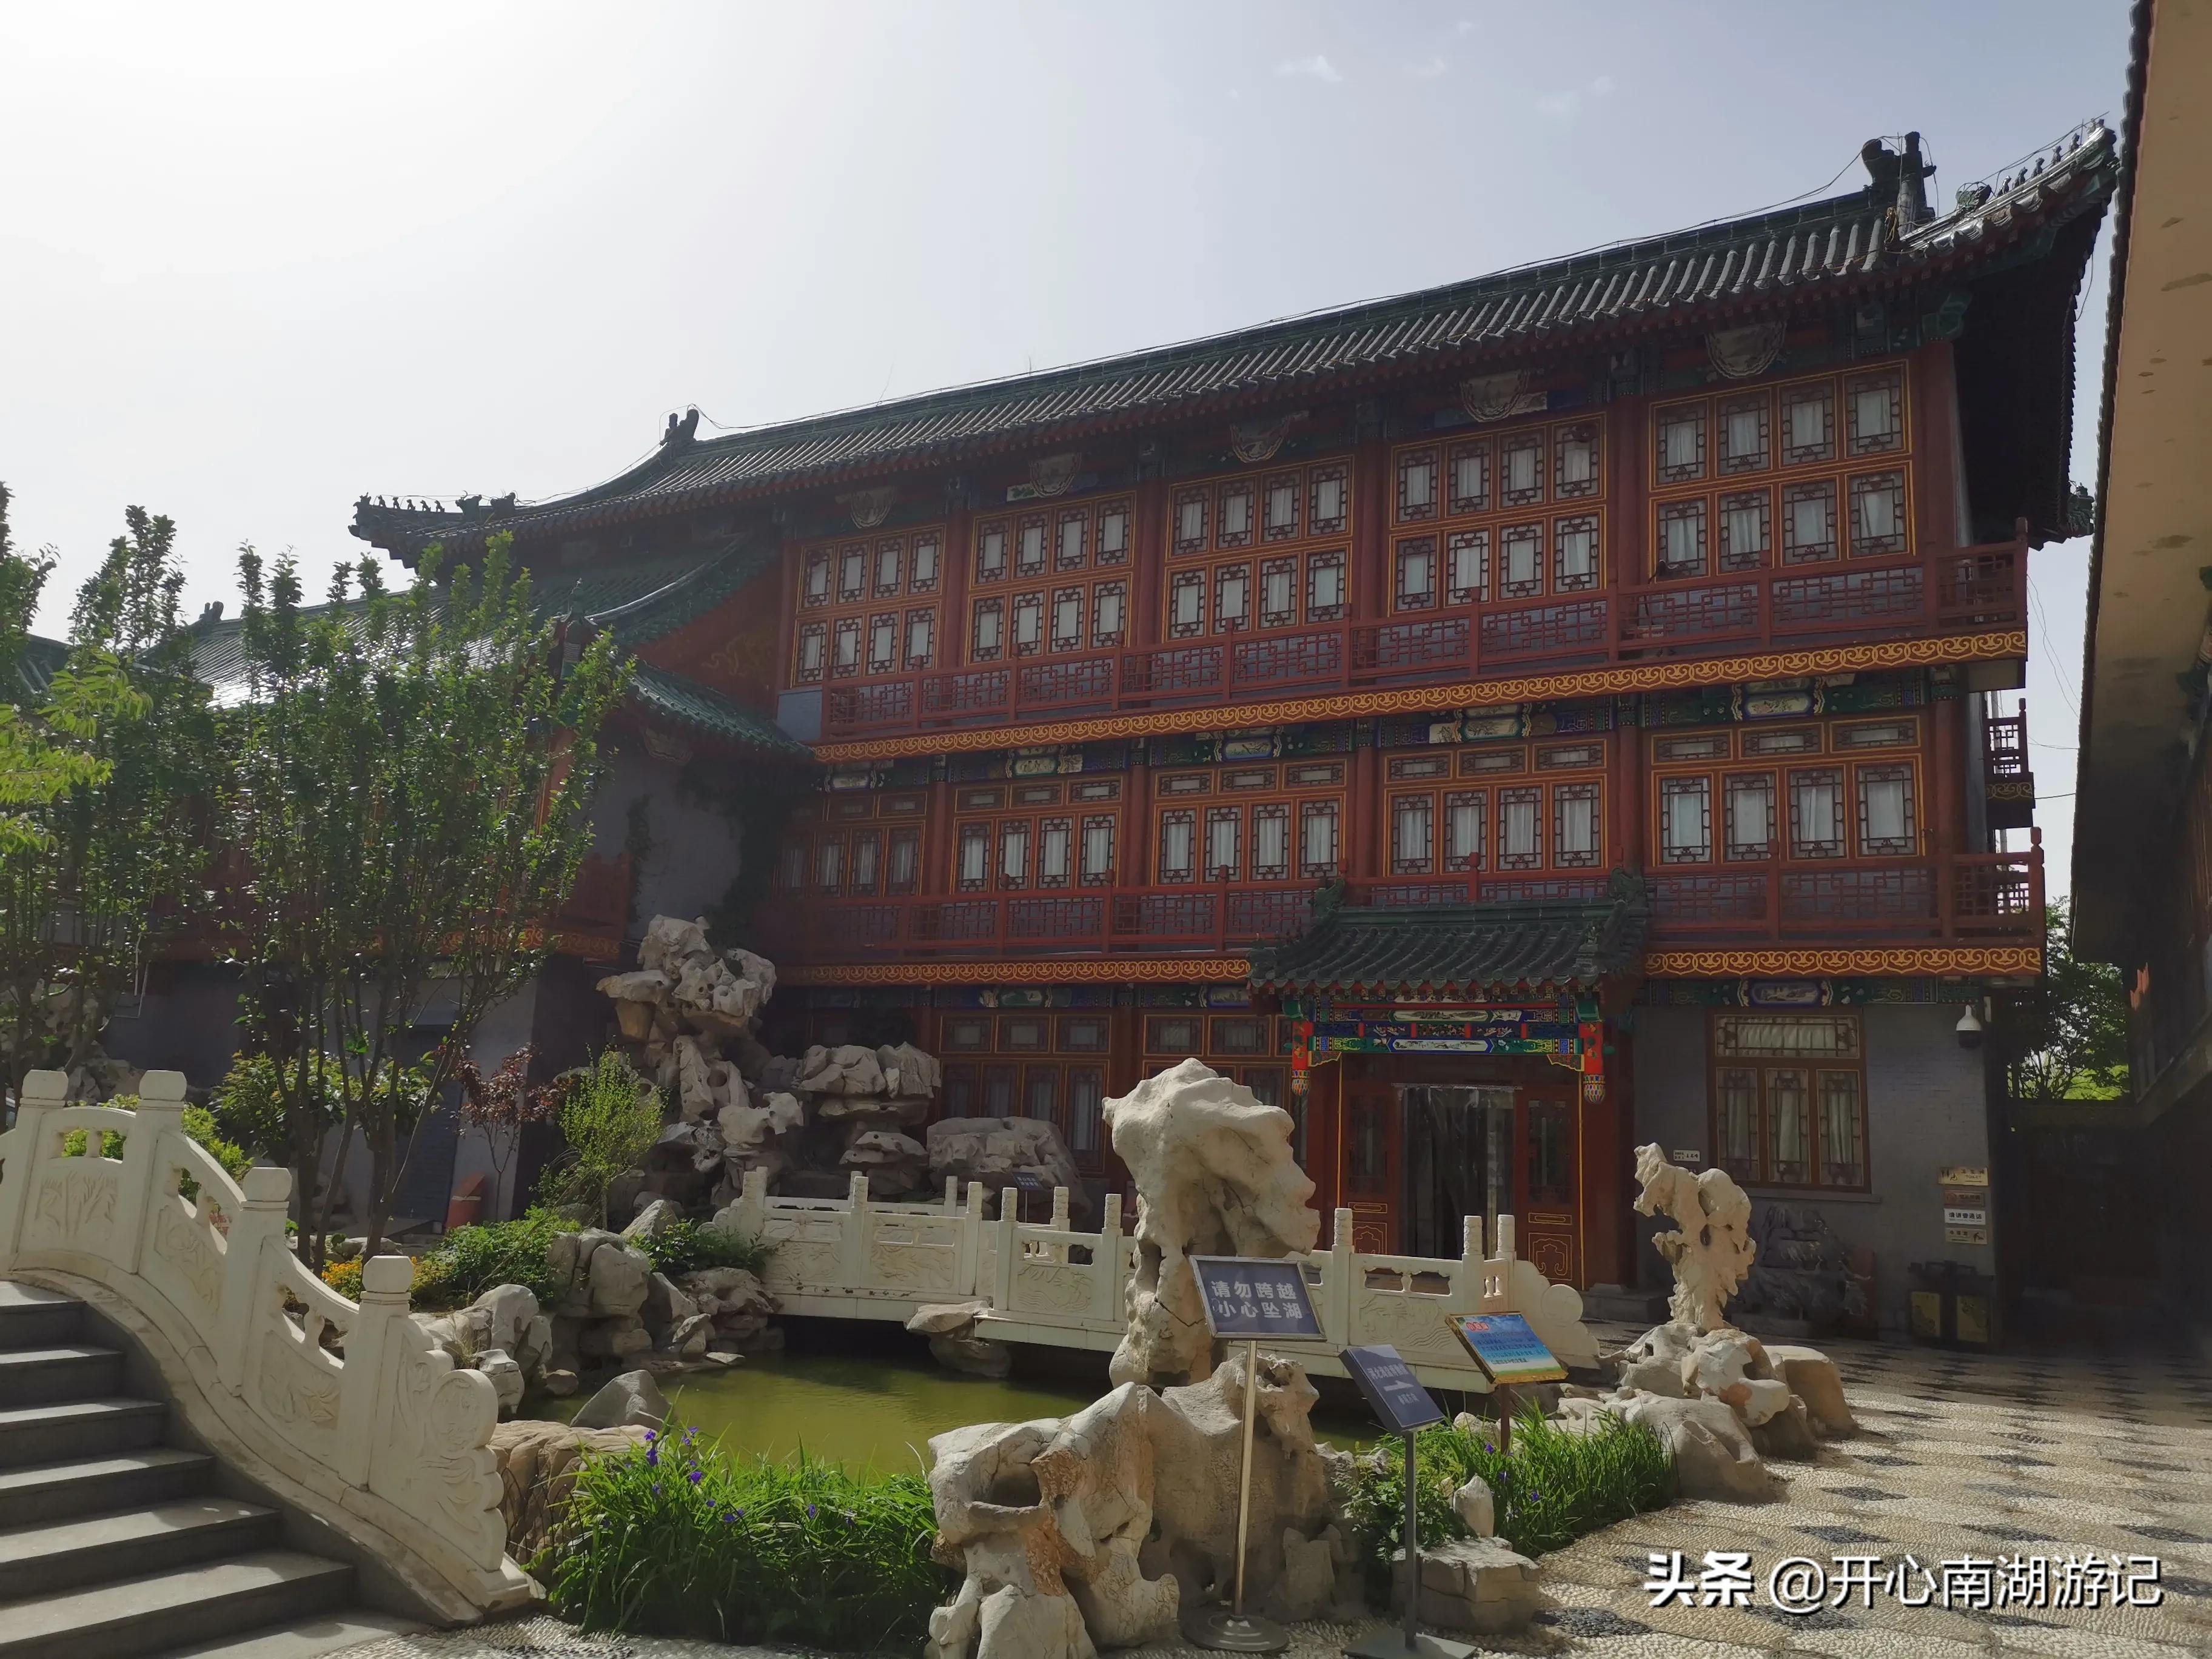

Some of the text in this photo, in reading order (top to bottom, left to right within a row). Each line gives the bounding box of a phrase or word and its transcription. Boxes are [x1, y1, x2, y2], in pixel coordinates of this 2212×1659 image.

[1211, 1280, 1298, 1299] 请勿跨越
[1218, 1299, 1303, 1319] 小心坠湖
